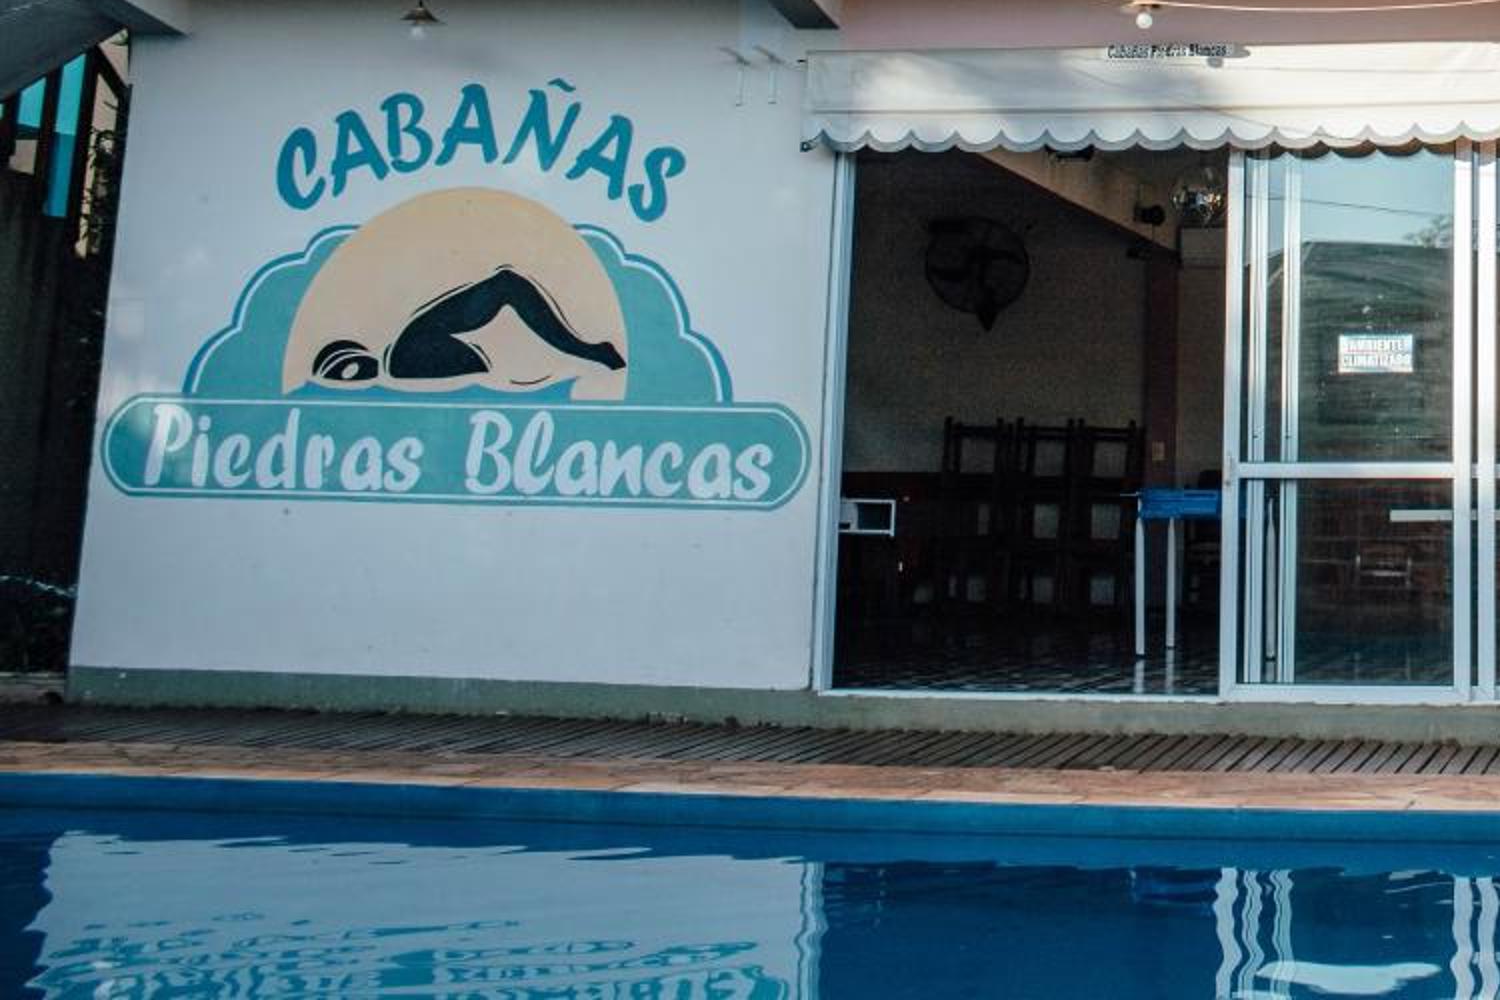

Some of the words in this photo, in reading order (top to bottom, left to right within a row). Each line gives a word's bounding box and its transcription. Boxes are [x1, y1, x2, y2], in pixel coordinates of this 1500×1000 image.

[275, 78, 687, 223] CABAÑAS
[143, 404, 421, 491] Piedras
[465, 410, 772, 498] Blancas
